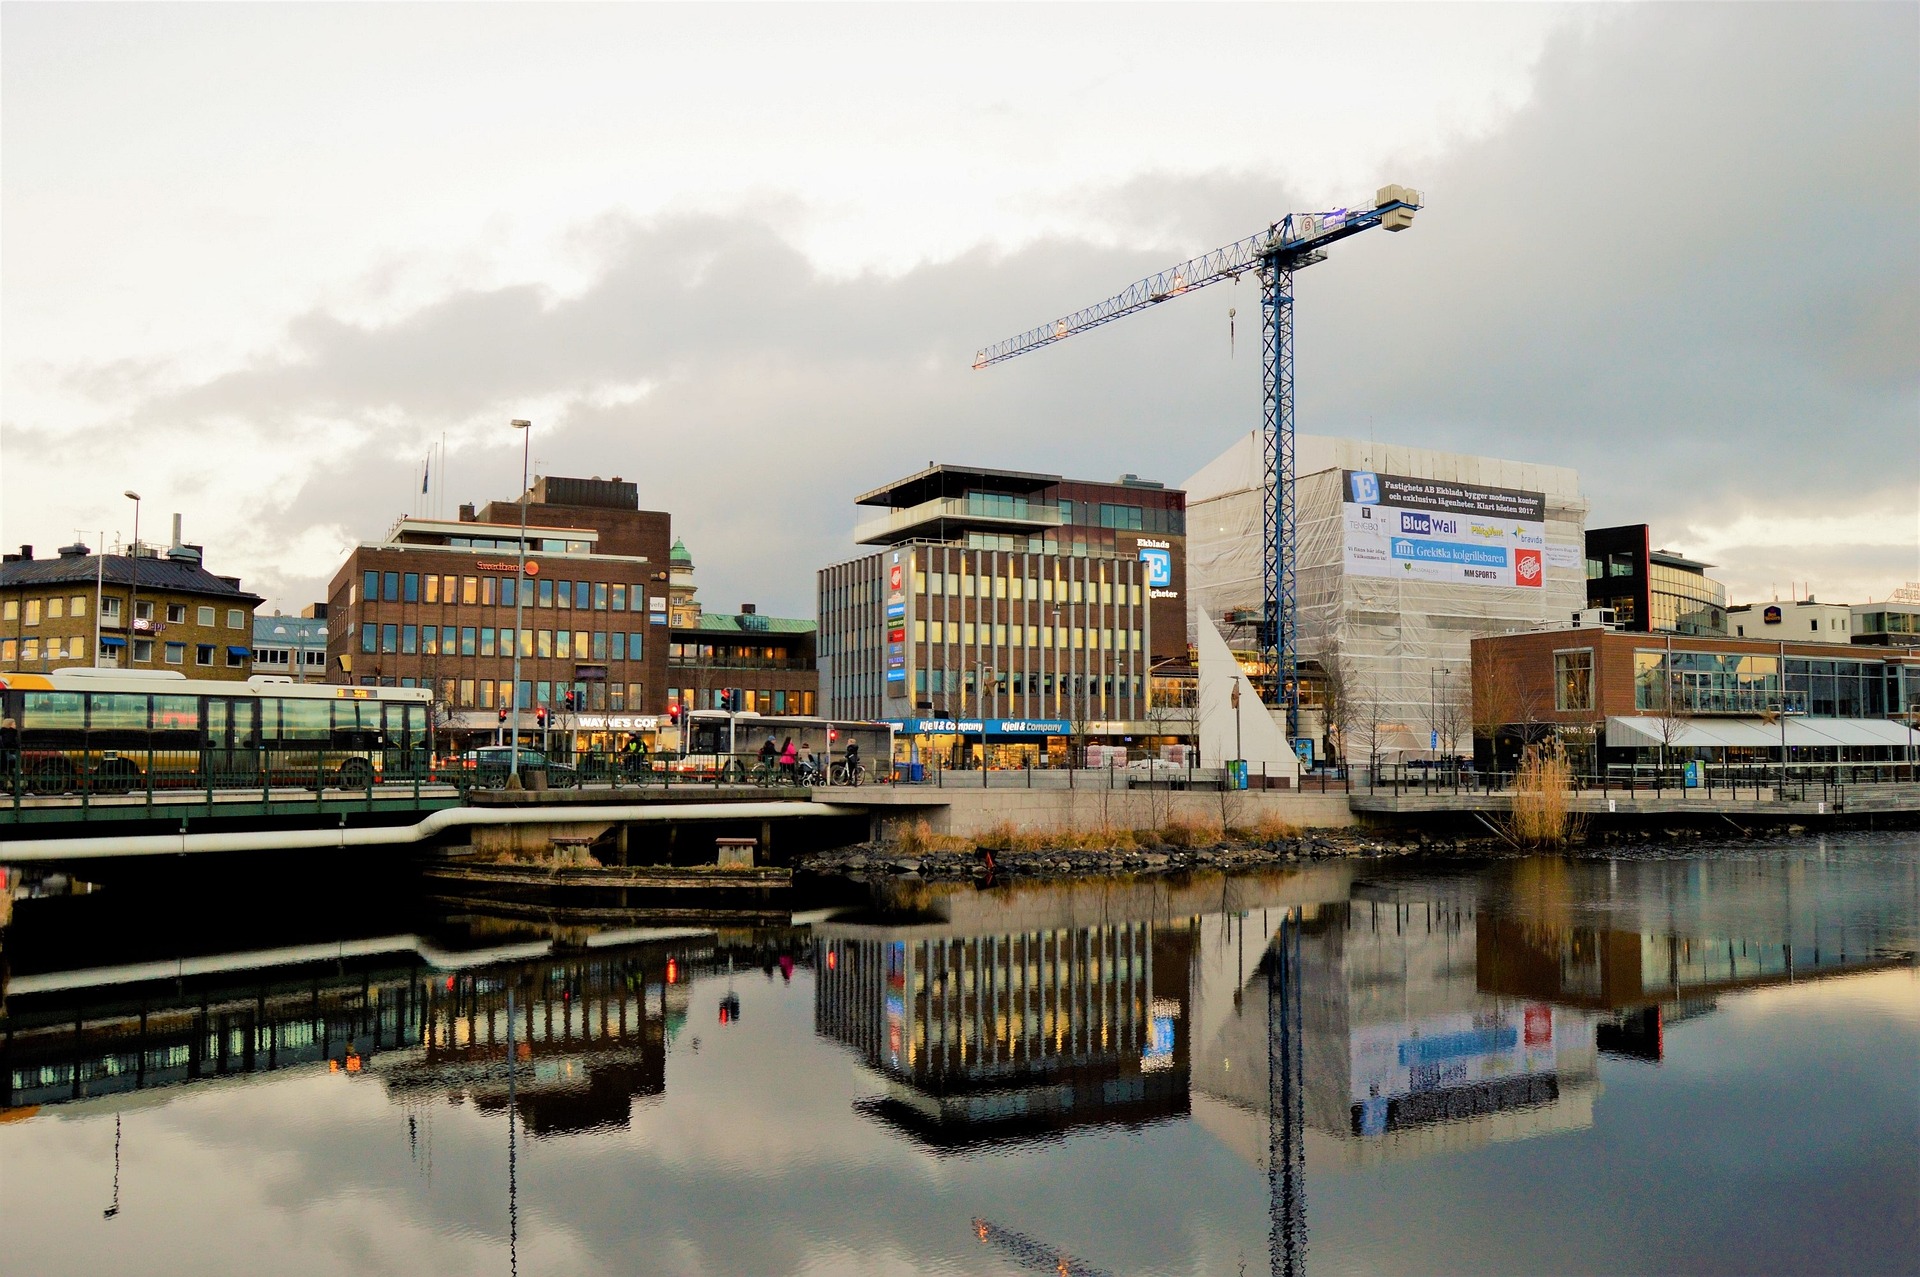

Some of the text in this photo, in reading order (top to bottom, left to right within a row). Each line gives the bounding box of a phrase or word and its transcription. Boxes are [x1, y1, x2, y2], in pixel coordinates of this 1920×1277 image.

[1353, 473, 1378, 502] E
[1385, 481, 1539, 505] Fastighets AB Ekblads bygger moderna kontor
[1389, 493, 1402, 501] och
[1402, 494, 1437, 504] exklusiva
[1476, 501, 1495, 510] Klart
[1496, 503, 1518, 513] hösten
[1349, 520, 1379, 531] TENGBO
[1403, 515, 1457, 534] Blue Wall
[1136, 538, 1170, 549] Ekblads
[1521, 535, 1543, 544] bravida
[1416, 545, 1505, 563] Grekiska kolgrillsbaren
[1464, 569, 1497, 579] MM SPORTS
[1149, 589, 1178, 599] igheter
[579, 717, 658, 728] WAYNE'S COF
[938, 721, 945, 731] &
[1001, 721, 1062, 732] Kjell & Company
